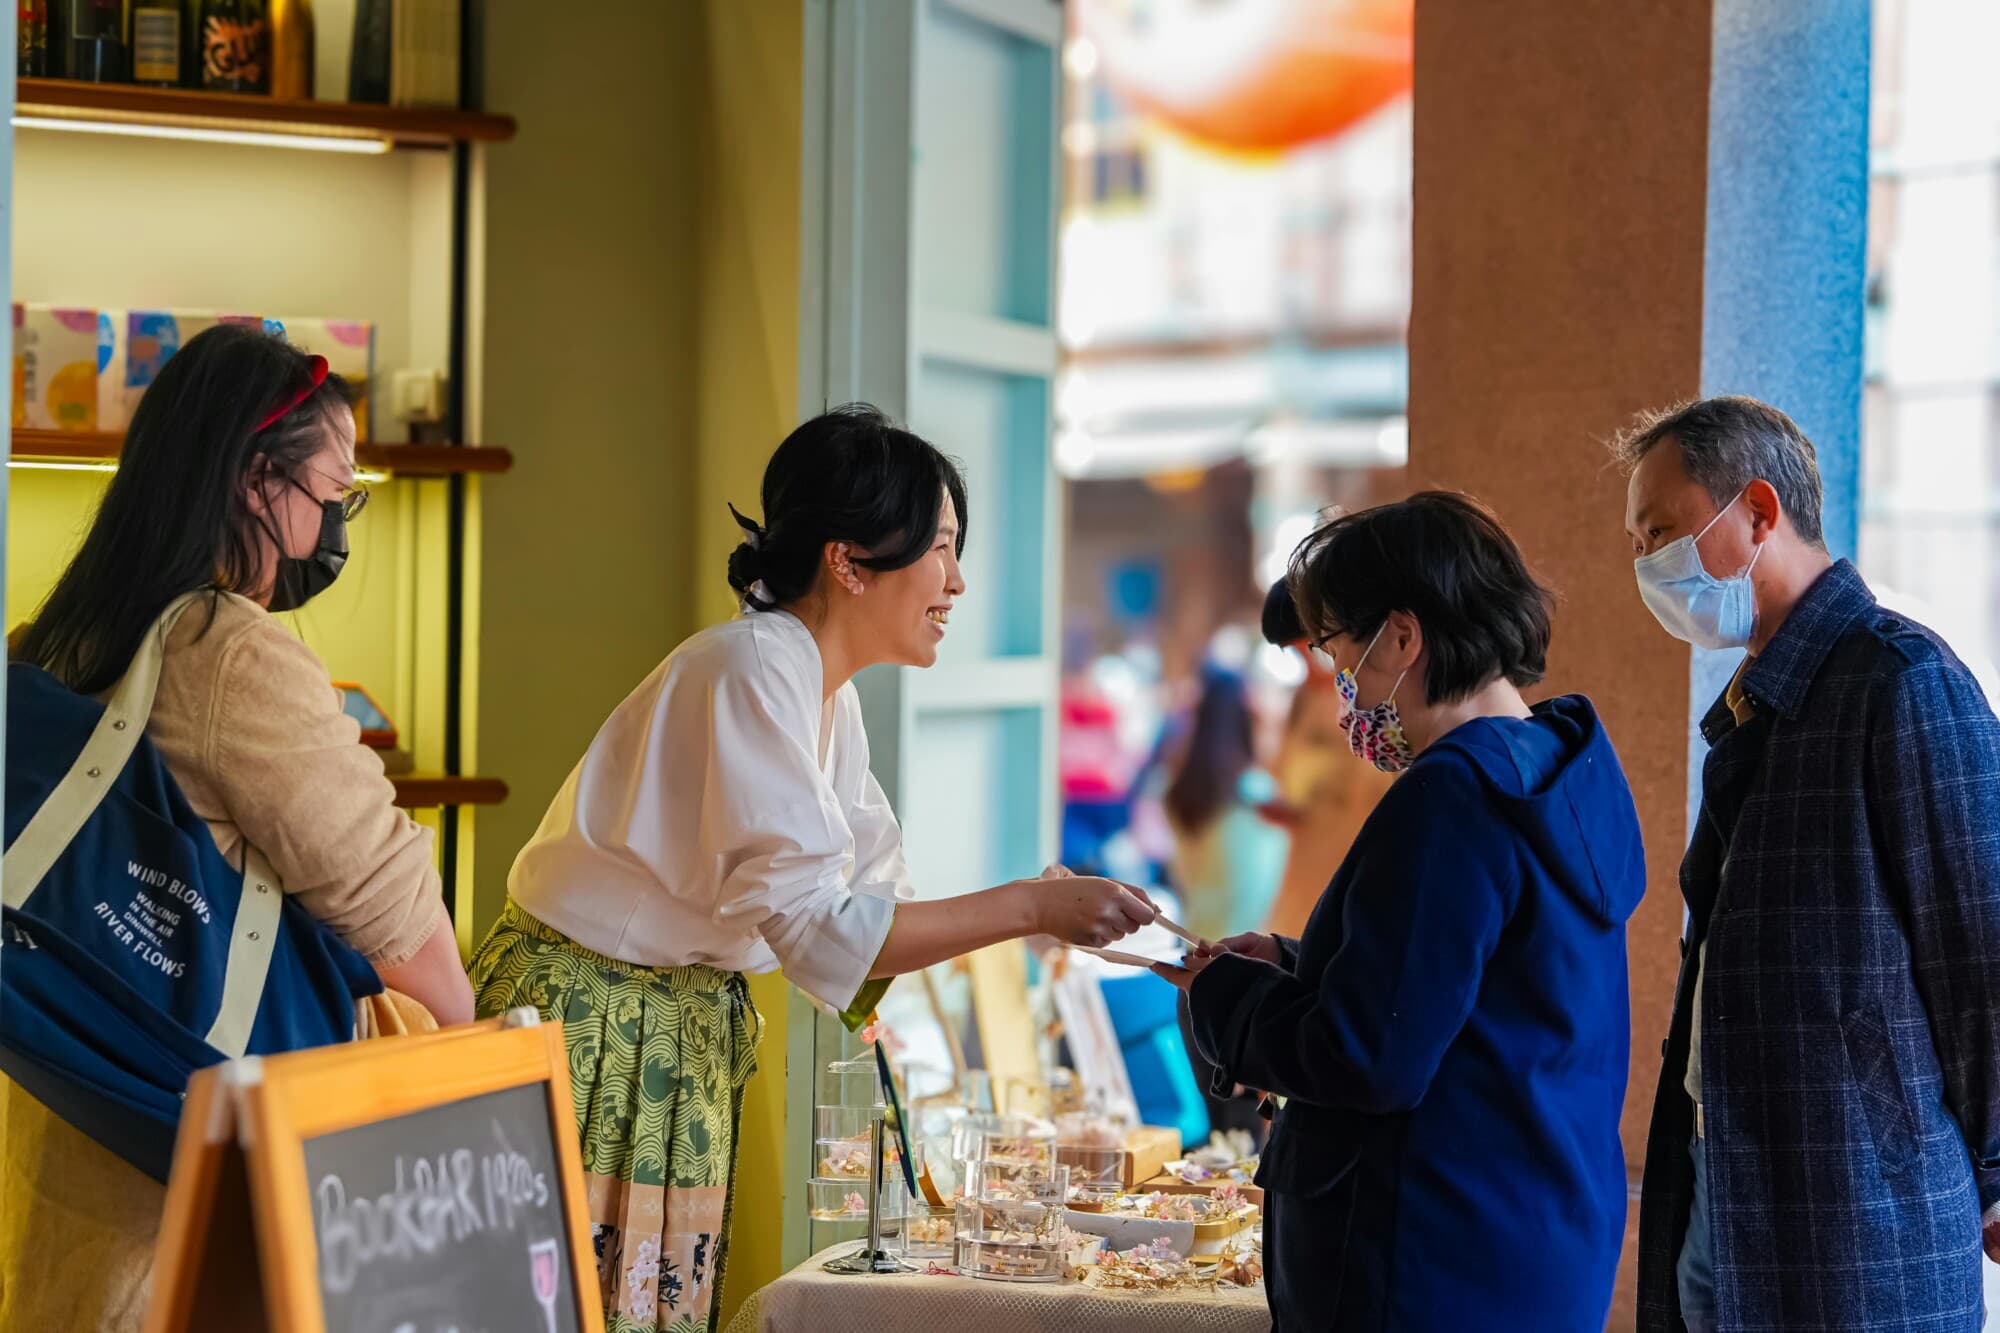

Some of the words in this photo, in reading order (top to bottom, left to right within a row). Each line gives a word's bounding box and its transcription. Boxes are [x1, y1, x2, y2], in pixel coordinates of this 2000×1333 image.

[127, 860, 167, 888] WIND
[168, 878, 211, 924] BLOWS
[136, 891, 181, 926] WALKING
[123, 911, 163, 948] DINIWELL
[129, 901, 140, 913] IN
[140, 911, 157, 928] THE
[156, 924, 174, 938] AIR
[94, 901, 134, 945] RIVER
[132, 940, 186, 978] FLOWS
